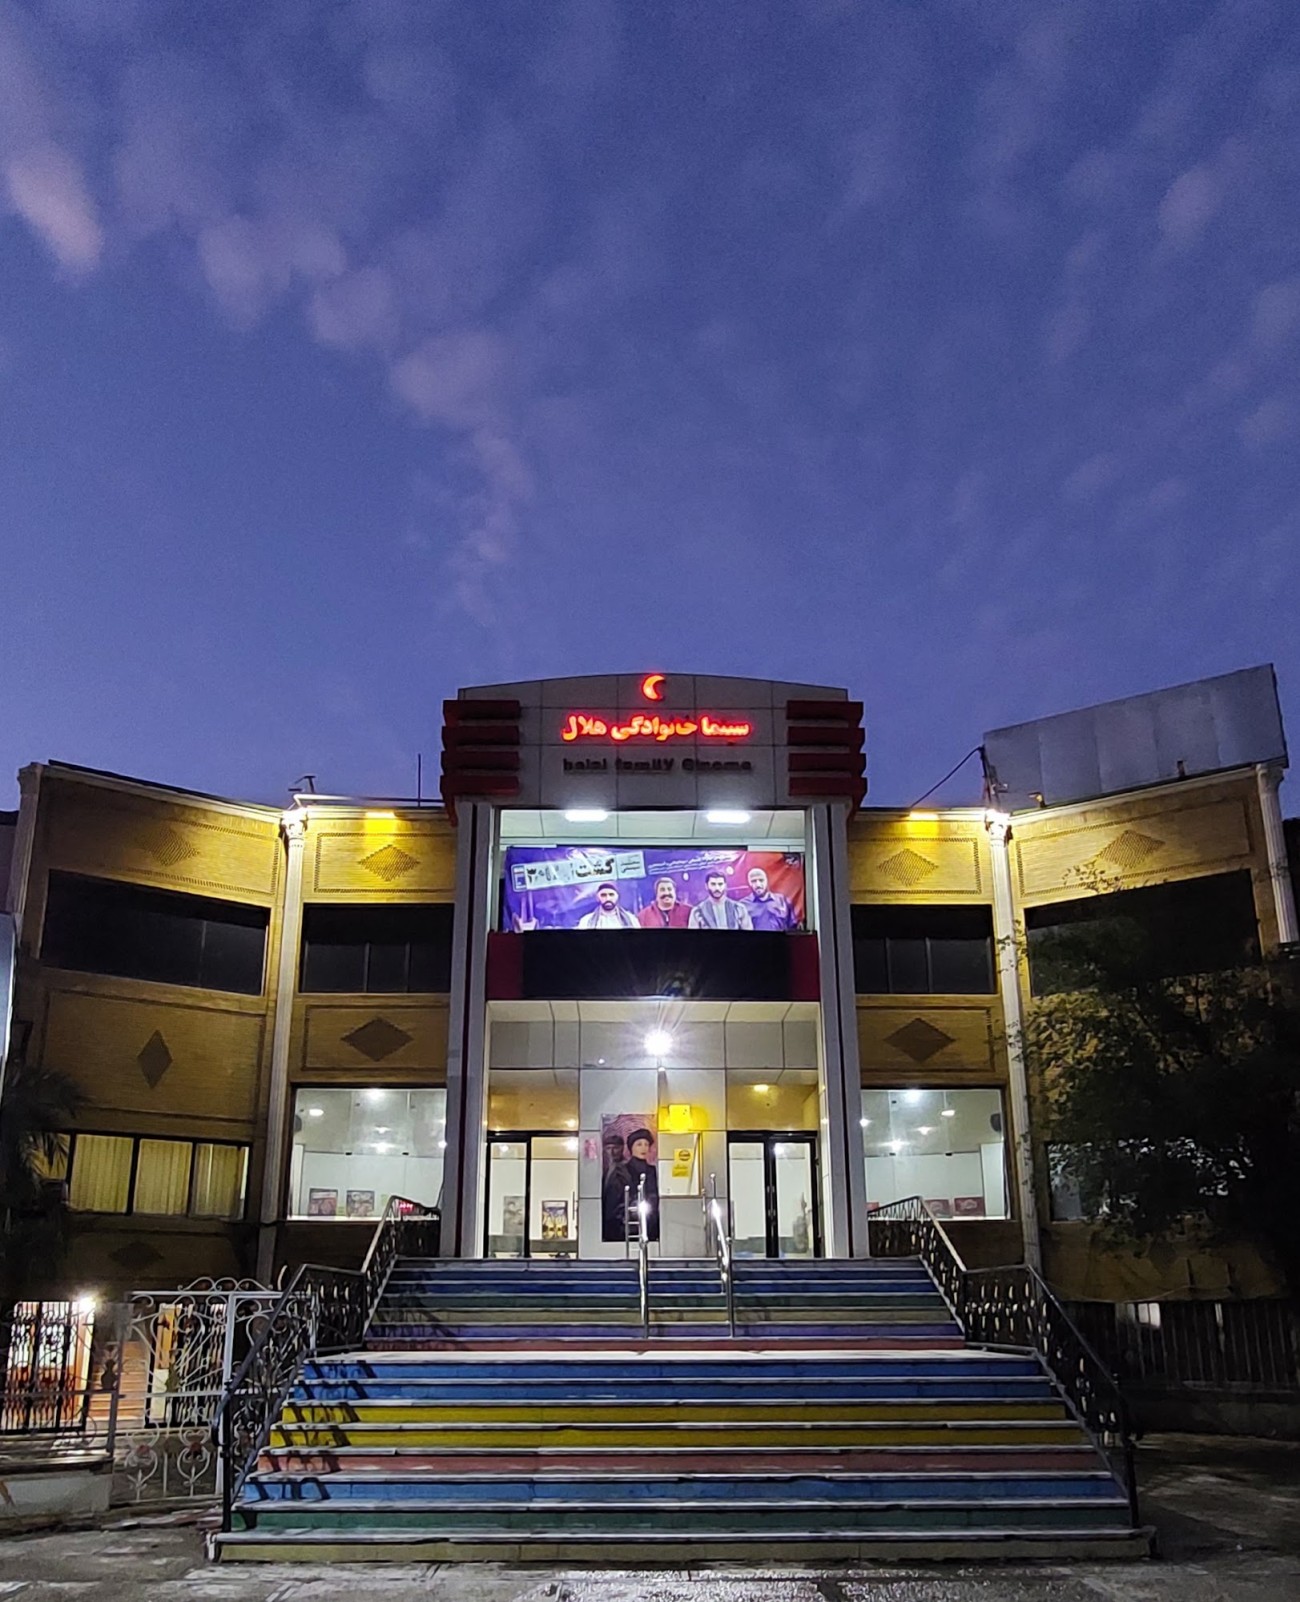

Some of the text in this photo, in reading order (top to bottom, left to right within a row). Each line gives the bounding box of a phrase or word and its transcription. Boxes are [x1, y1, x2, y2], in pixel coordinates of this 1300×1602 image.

[562, 714, 751, 743] سینما خانوادگی هلال
